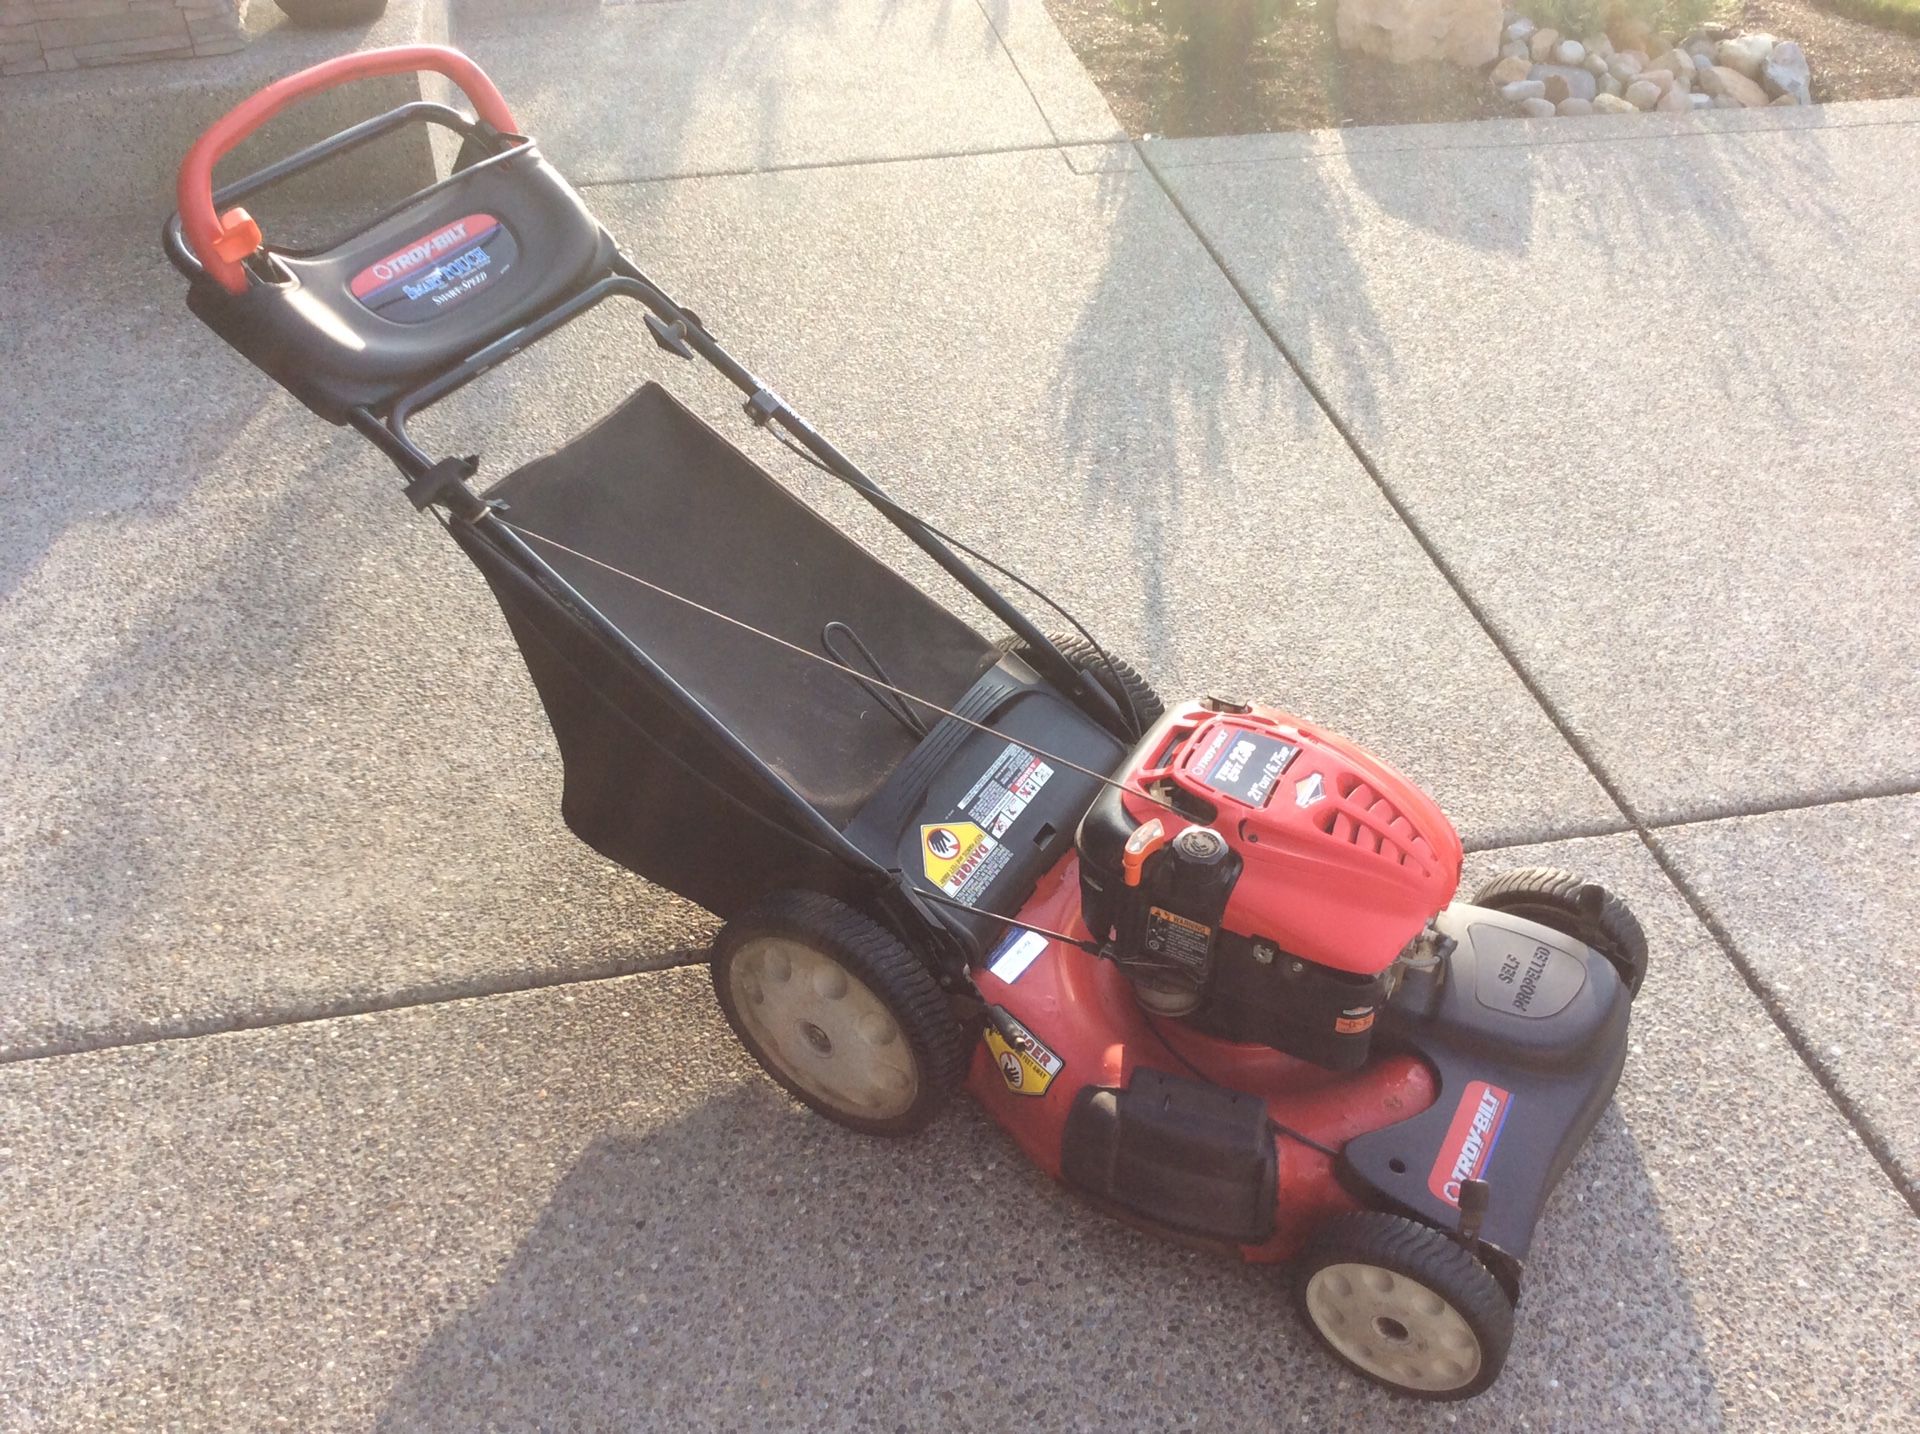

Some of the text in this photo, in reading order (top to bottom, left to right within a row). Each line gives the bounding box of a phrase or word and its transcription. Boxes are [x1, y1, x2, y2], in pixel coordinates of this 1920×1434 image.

[387, 223, 467, 272] TROY-BILT
[1196, 729, 1229, 769] TROY-BILT
[950, 842, 989, 887] DANGER
[1498, 953, 1521, 984] SELF
[1512, 946, 1551, 1012] PROPELLED
[1452, 1087, 1498, 1181] TROY-BILT
